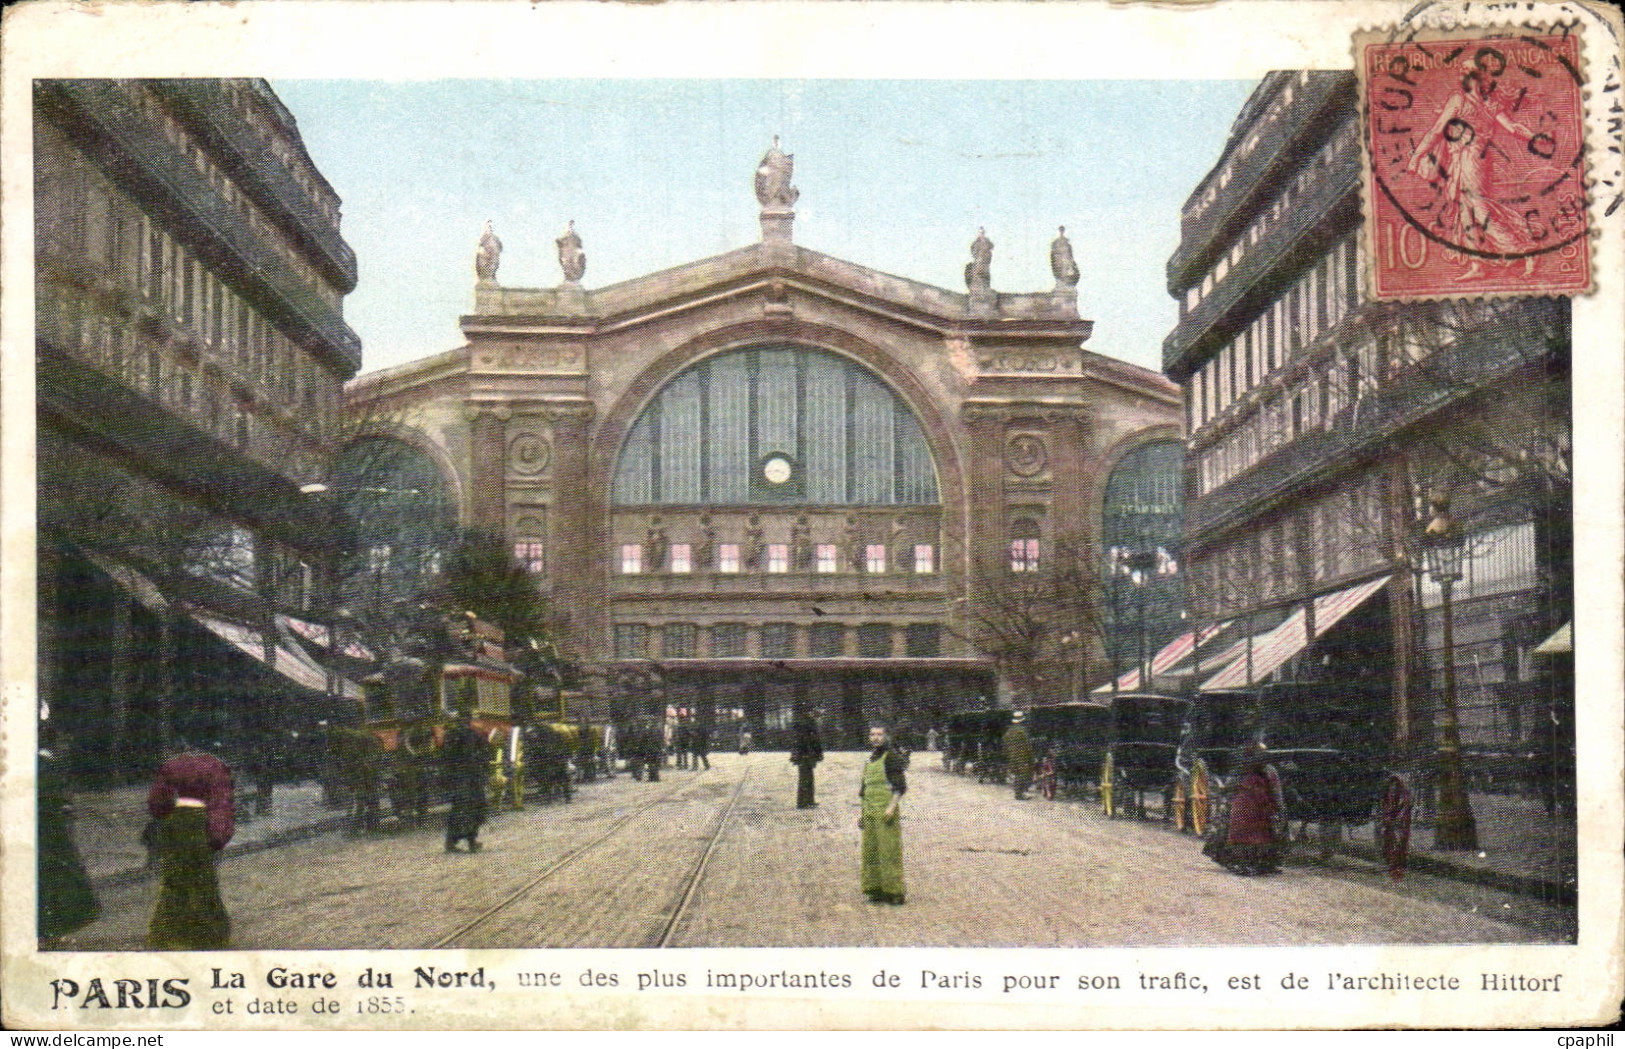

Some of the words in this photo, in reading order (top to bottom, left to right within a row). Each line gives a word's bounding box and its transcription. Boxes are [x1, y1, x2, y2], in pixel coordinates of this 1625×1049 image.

[1559, 193, 1578, 273] POSTES
[49, 977, 192, 1010] PARIS
[211, 967, 246, 990] La
[266, 967, 338, 990] Gare
[358, 967, 394, 989] du
[414, 966, 496, 991] Nord,
[517, 971, 561, 988] une
[579, 968, 619, 988] des
[637, 968, 687, 992] plus
[706, 968, 852, 992] importantes
[872, 969, 901, 989] de
[920, 968, 983, 990] Paris
[1002, 973, 1060, 994] pour
[1078, 974, 1121, 991] son
[1139, 971, 1209, 994] trafic,
[1227, 973, 1262, 991] est
[1280, 971, 1310, 991] de
[1481, 972, 1564, 993] Hittorf
[211, 997, 235, 1016] et
[246, 996, 299, 1016] date
[311, 995, 341, 1016] de
[356, 995, 417, 1016] 1855.
